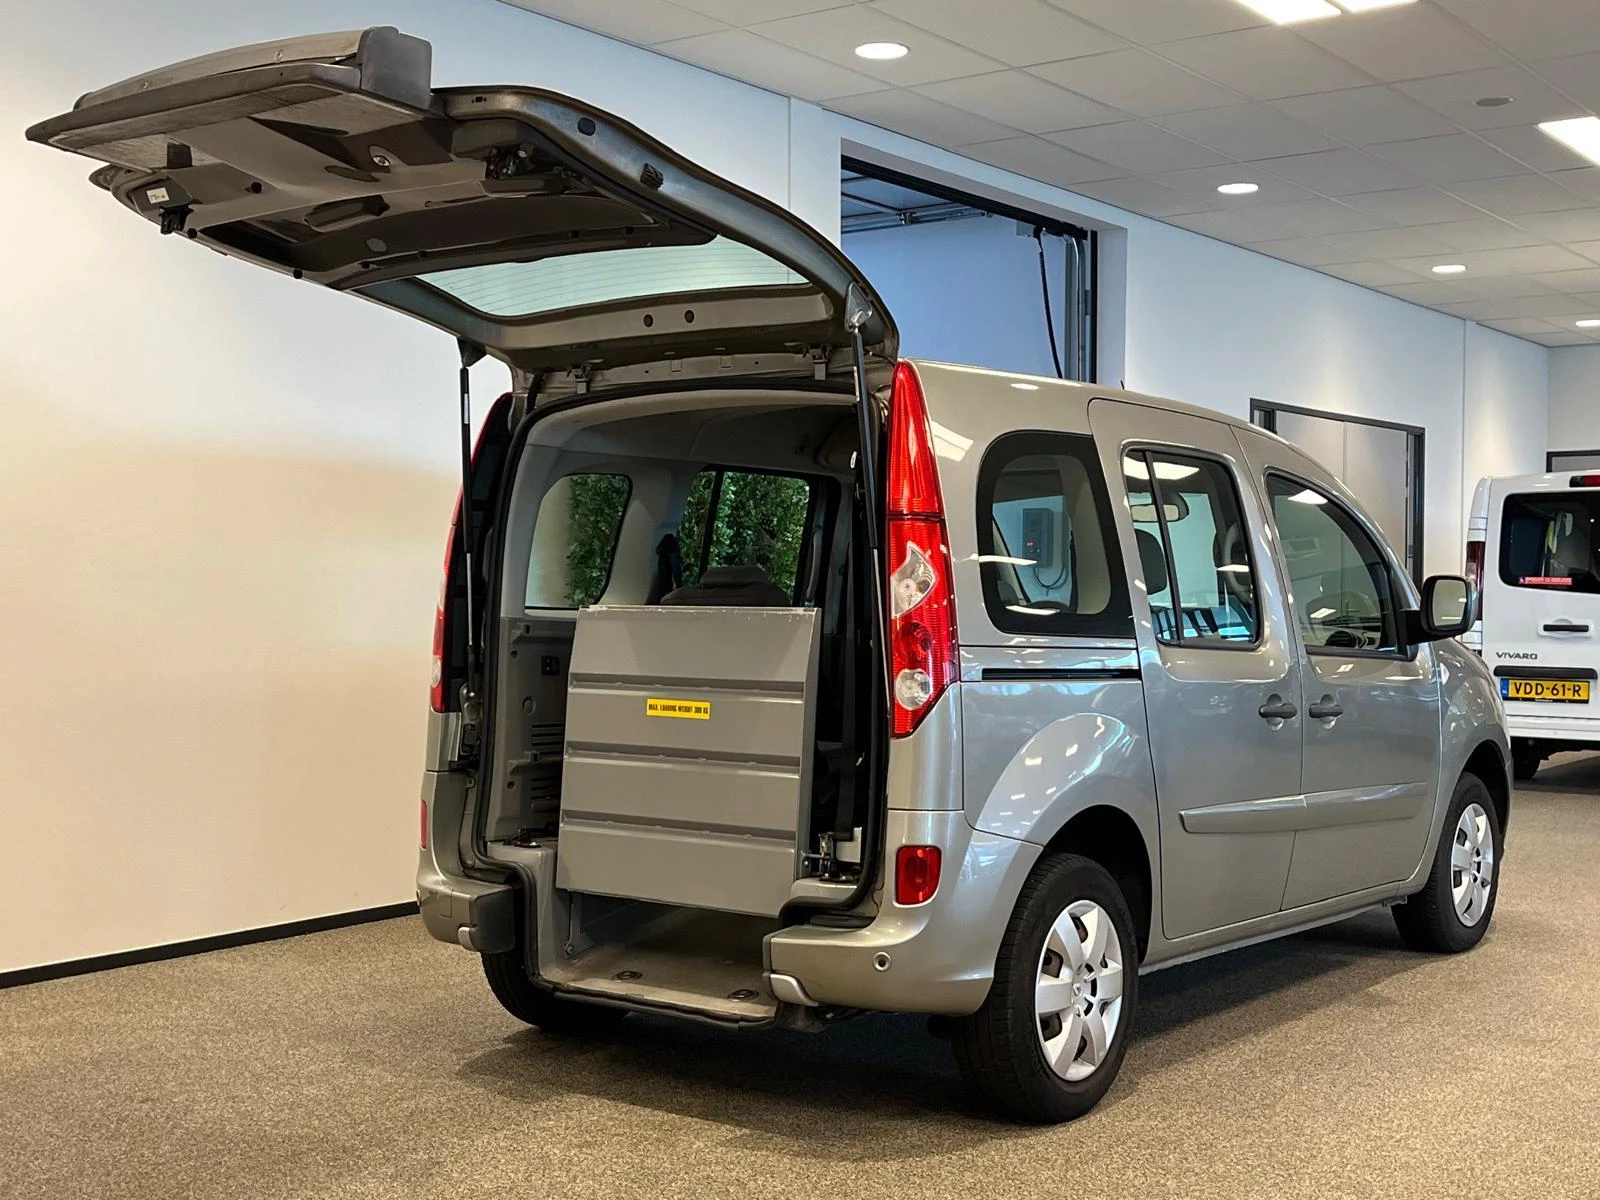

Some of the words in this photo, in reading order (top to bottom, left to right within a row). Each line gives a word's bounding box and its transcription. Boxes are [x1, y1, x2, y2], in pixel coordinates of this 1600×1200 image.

[1496, 652, 1538, 660] VIVARO
[1514, 682, 1581, 697] VDD-61-R
[660, 704, 677, 712] LOADING
[678, 705, 693, 713] WEIGHT
